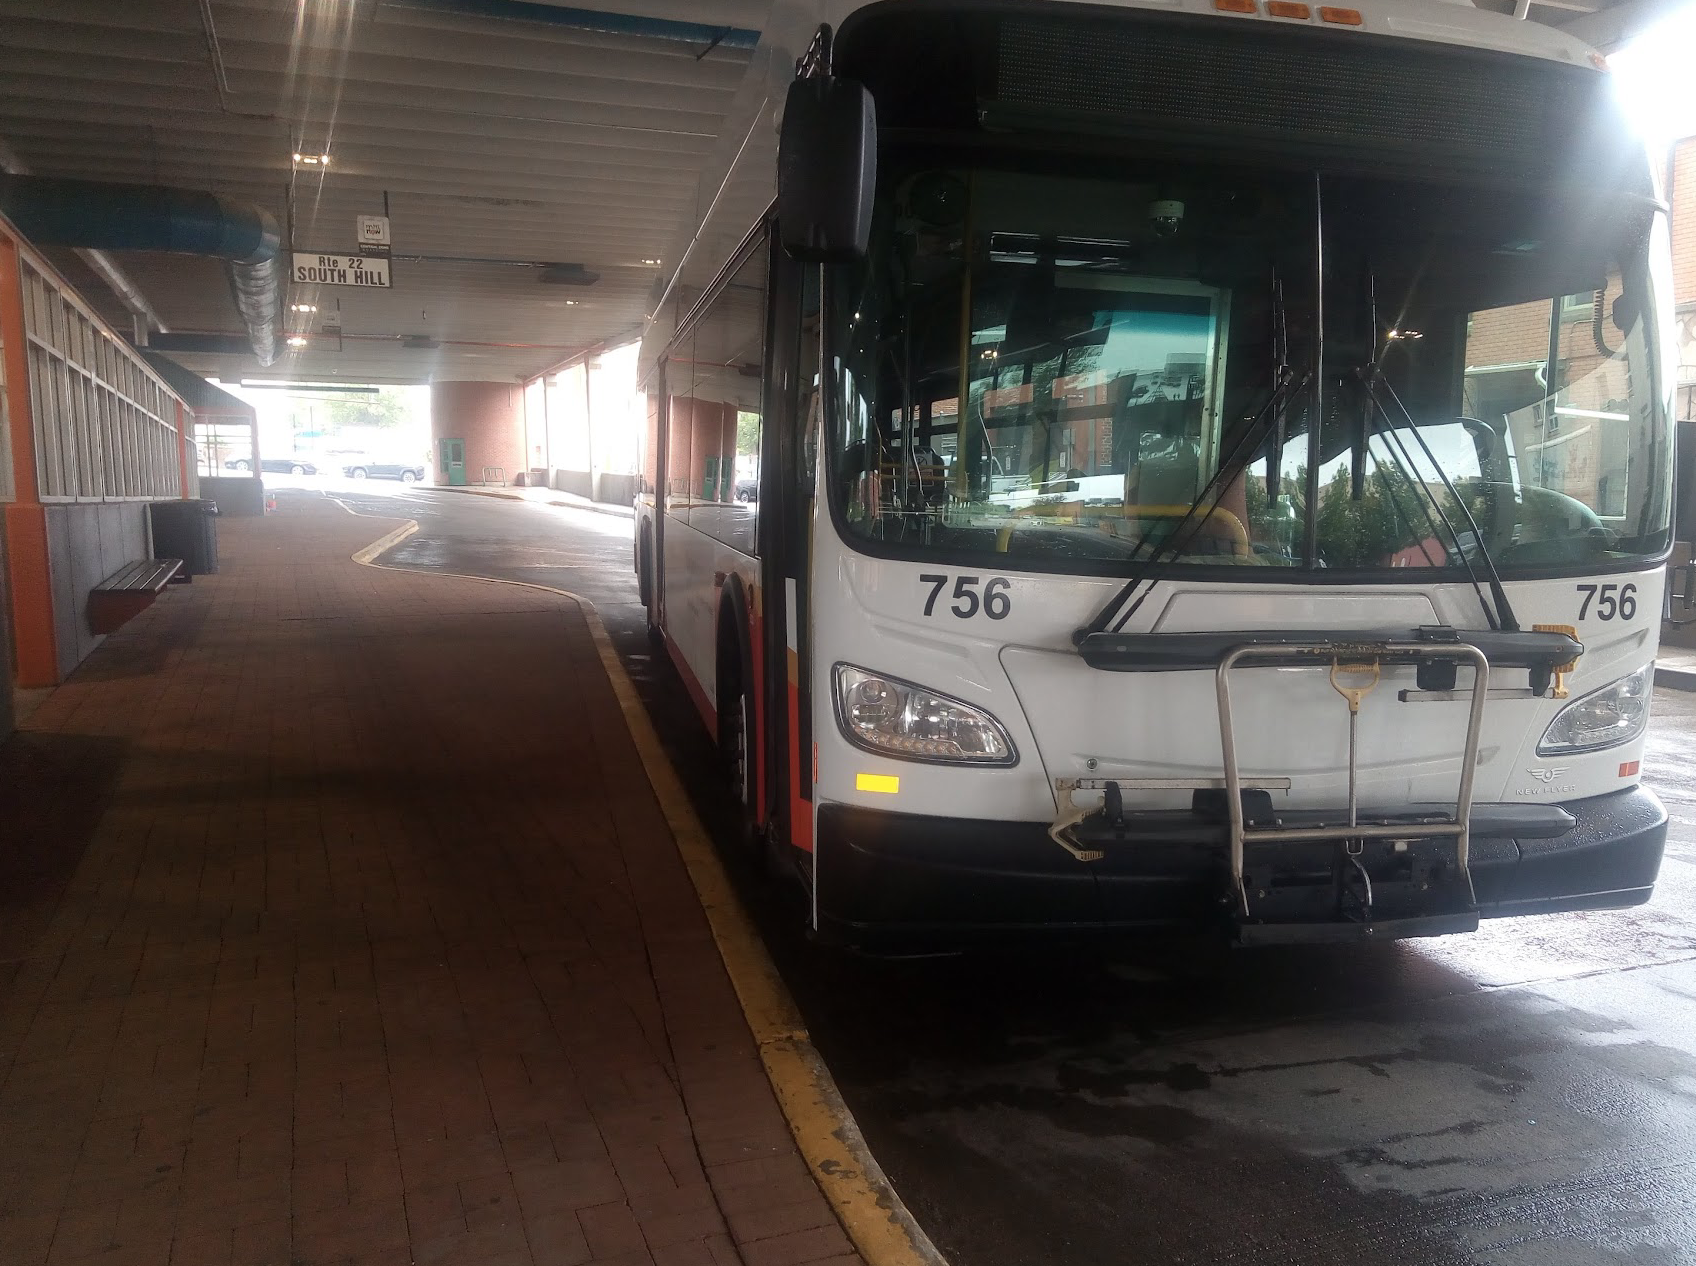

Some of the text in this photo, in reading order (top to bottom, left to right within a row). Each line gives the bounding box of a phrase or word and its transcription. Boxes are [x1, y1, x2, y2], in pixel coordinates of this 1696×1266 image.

[318, 256, 364, 269] Rte 22
[297, 266, 386, 286] SOUTH HILL
[920, 574, 1011, 620] 756
[1577, 583, 1637, 621] 756
[1516, 784, 1576, 797] NEW FLYER
